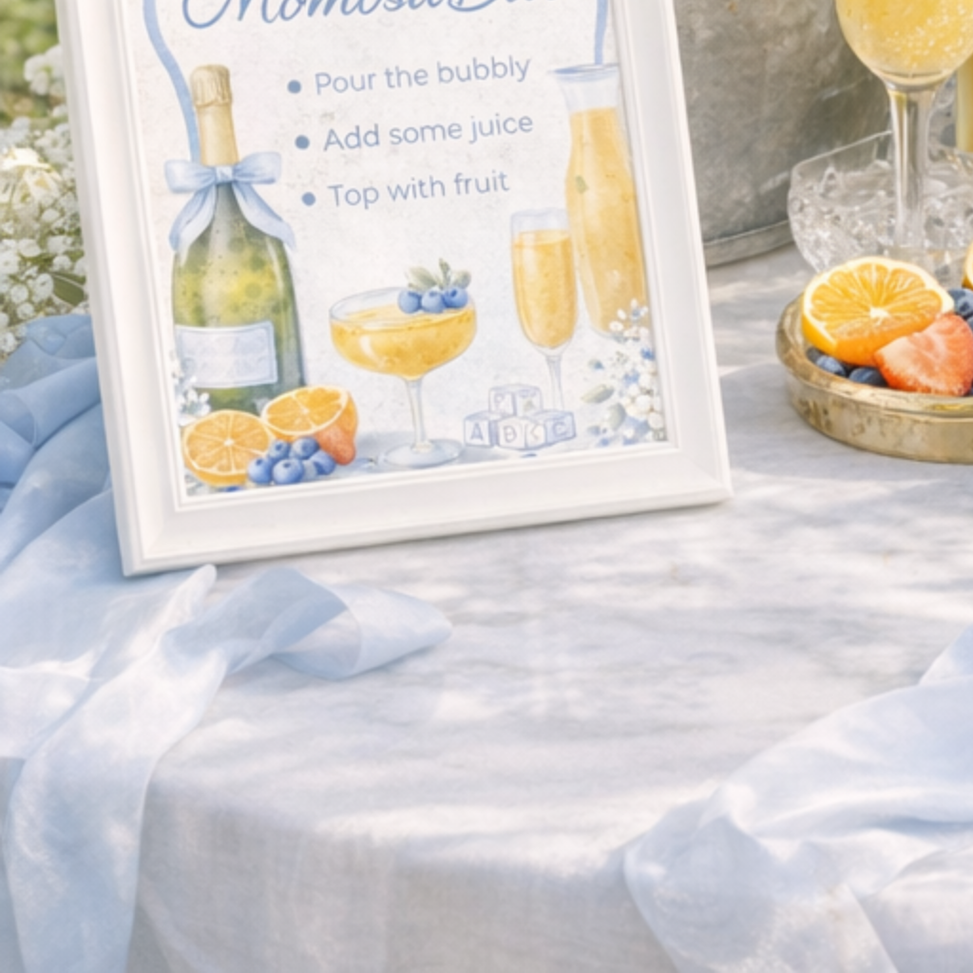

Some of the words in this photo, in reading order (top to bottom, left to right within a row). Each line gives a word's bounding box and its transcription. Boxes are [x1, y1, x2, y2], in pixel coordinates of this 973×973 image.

[314, 71, 377, 95] Pour
[383, 65, 430, 89] the
[436, 55, 532, 83] bubbly
[323, 123, 381, 151] Add
[388, 120, 463, 146] some
[470, 113, 534, 143] juice
[328, 183, 380, 210] Top
[386, 175, 446, 202] with
[452, 169, 511, 195] fruit
